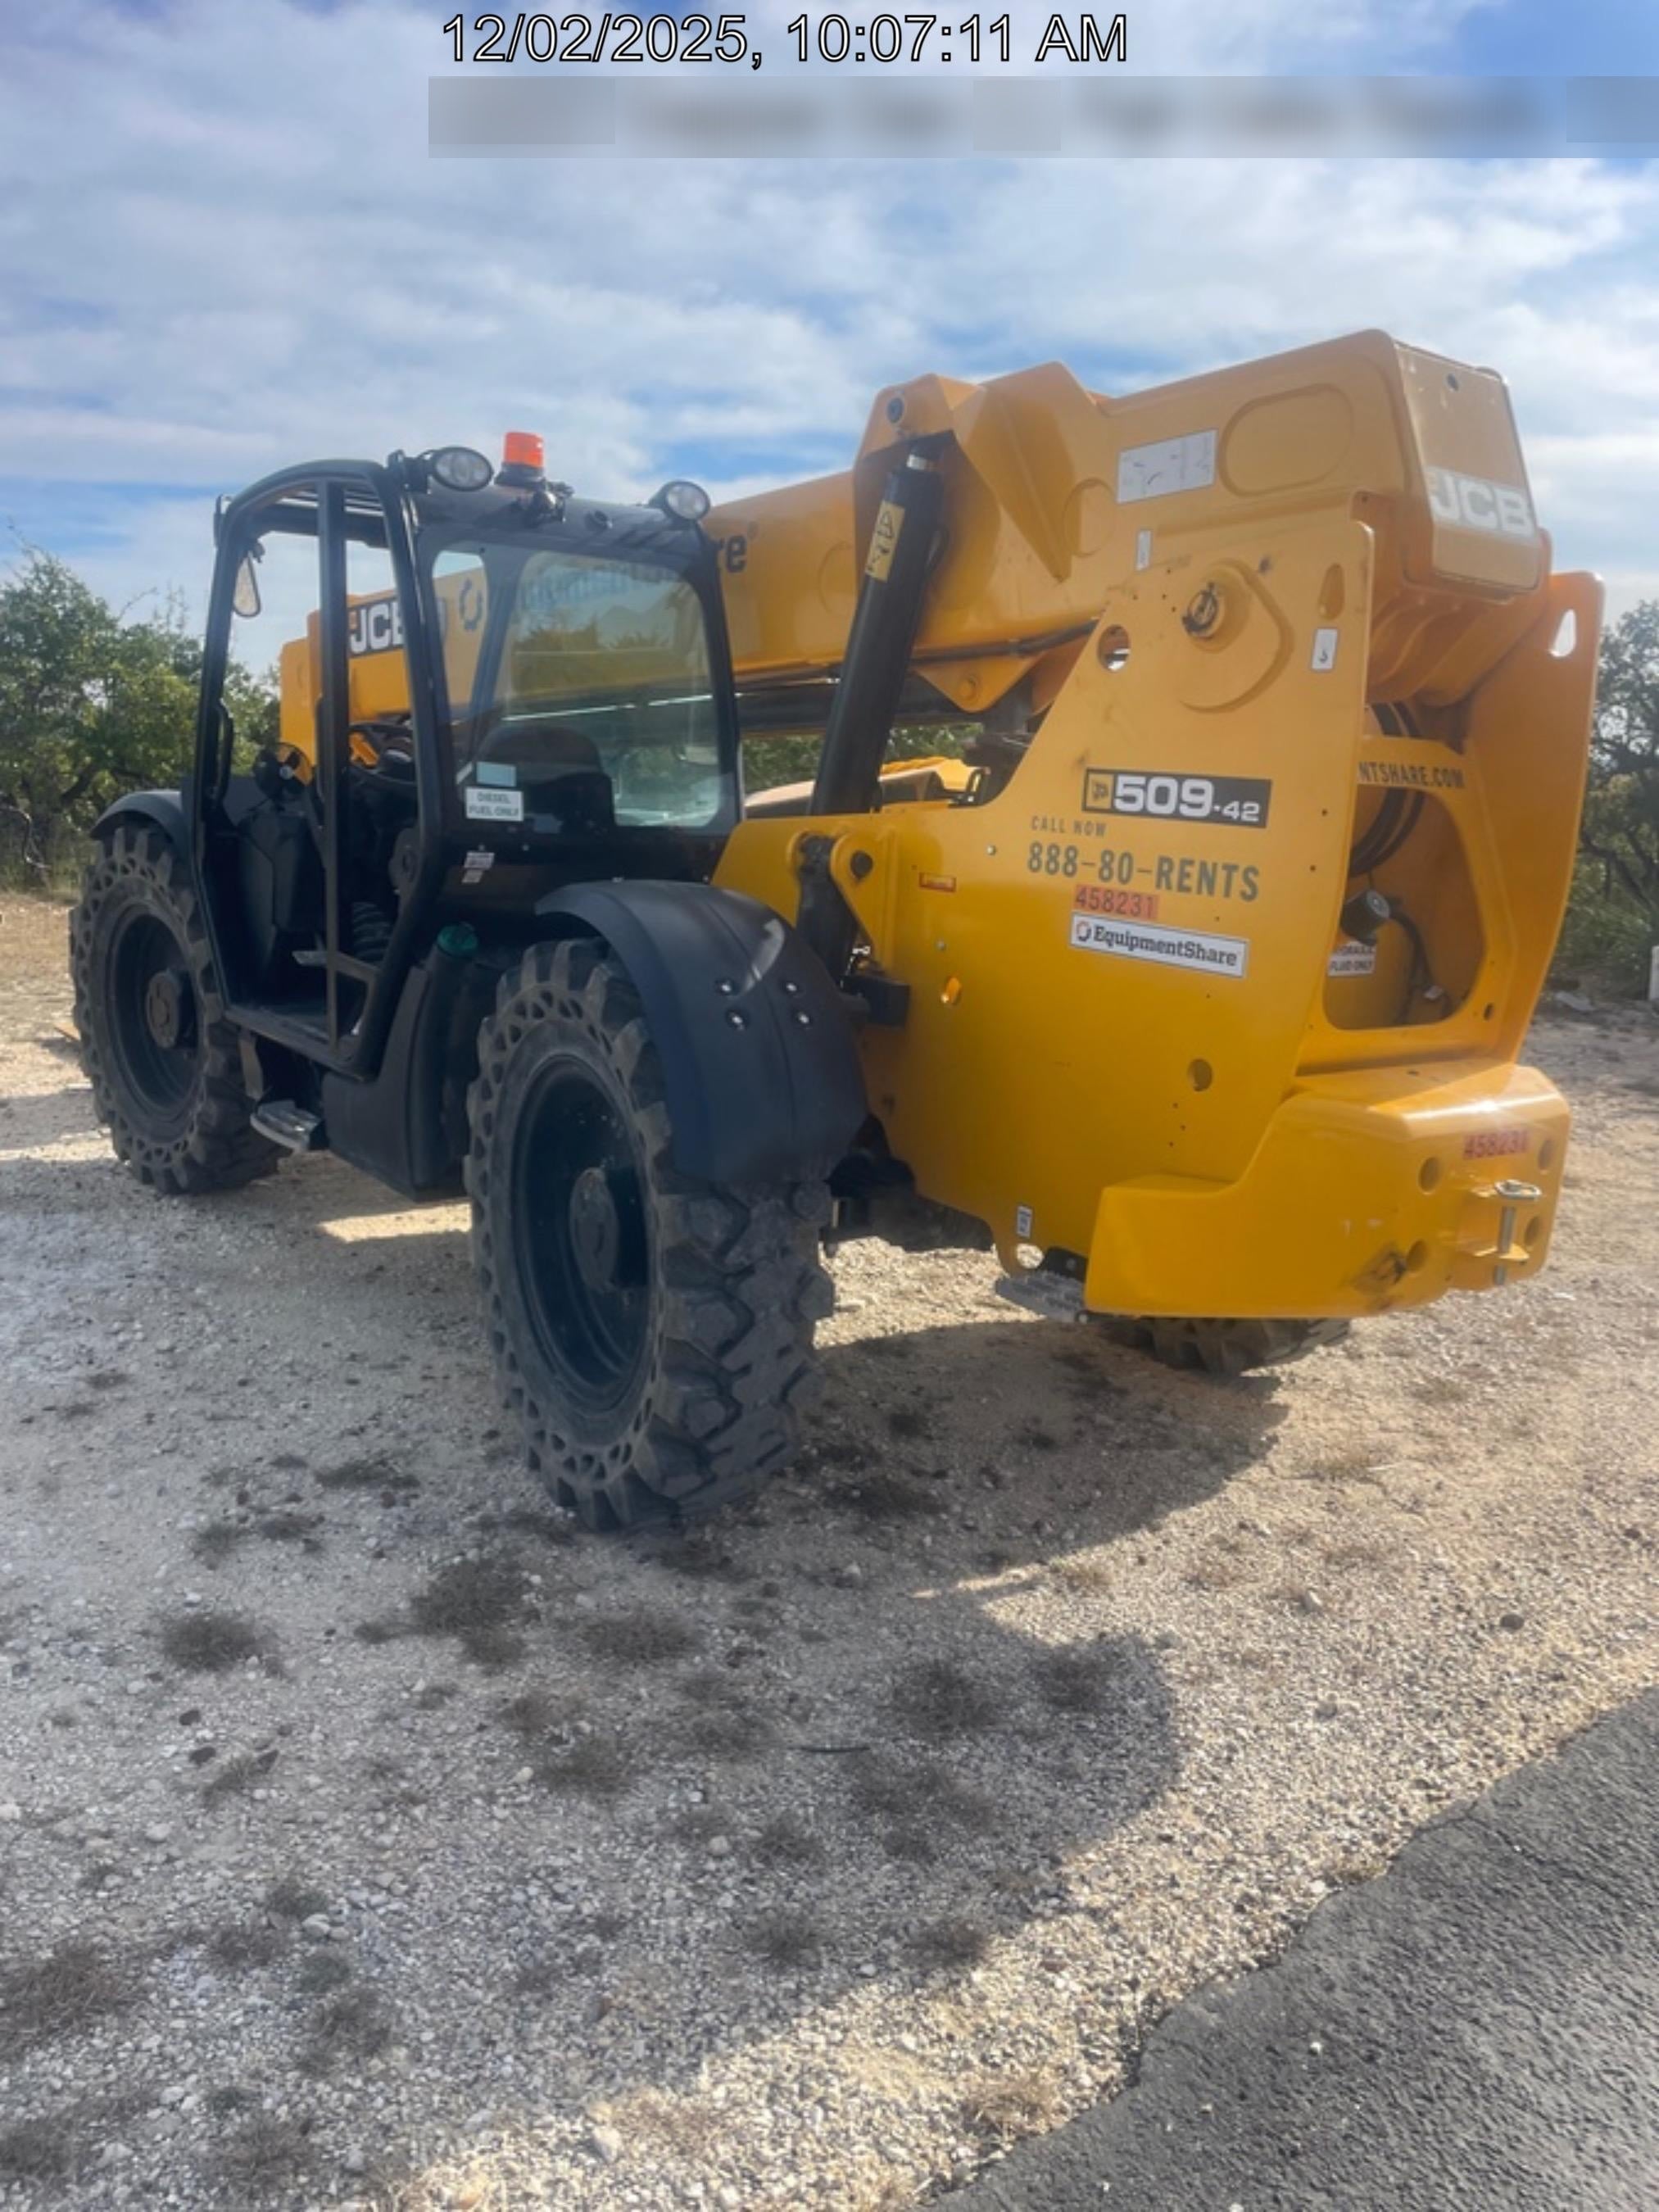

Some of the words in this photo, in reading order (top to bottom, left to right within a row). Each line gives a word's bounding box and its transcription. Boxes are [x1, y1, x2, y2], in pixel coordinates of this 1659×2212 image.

[1429, 471, 1535, 537] JCB
[477, 791, 511, 805] DIESEL
[1031, 816, 1066, 834] CALL
[1074, 821, 1106, 837] NOW
[1027, 841, 1260, 902] 888-80-RENTS
[1075, 886, 1156, 918] 458231
[1093, 925, 1238, 966] EquipmentShare
